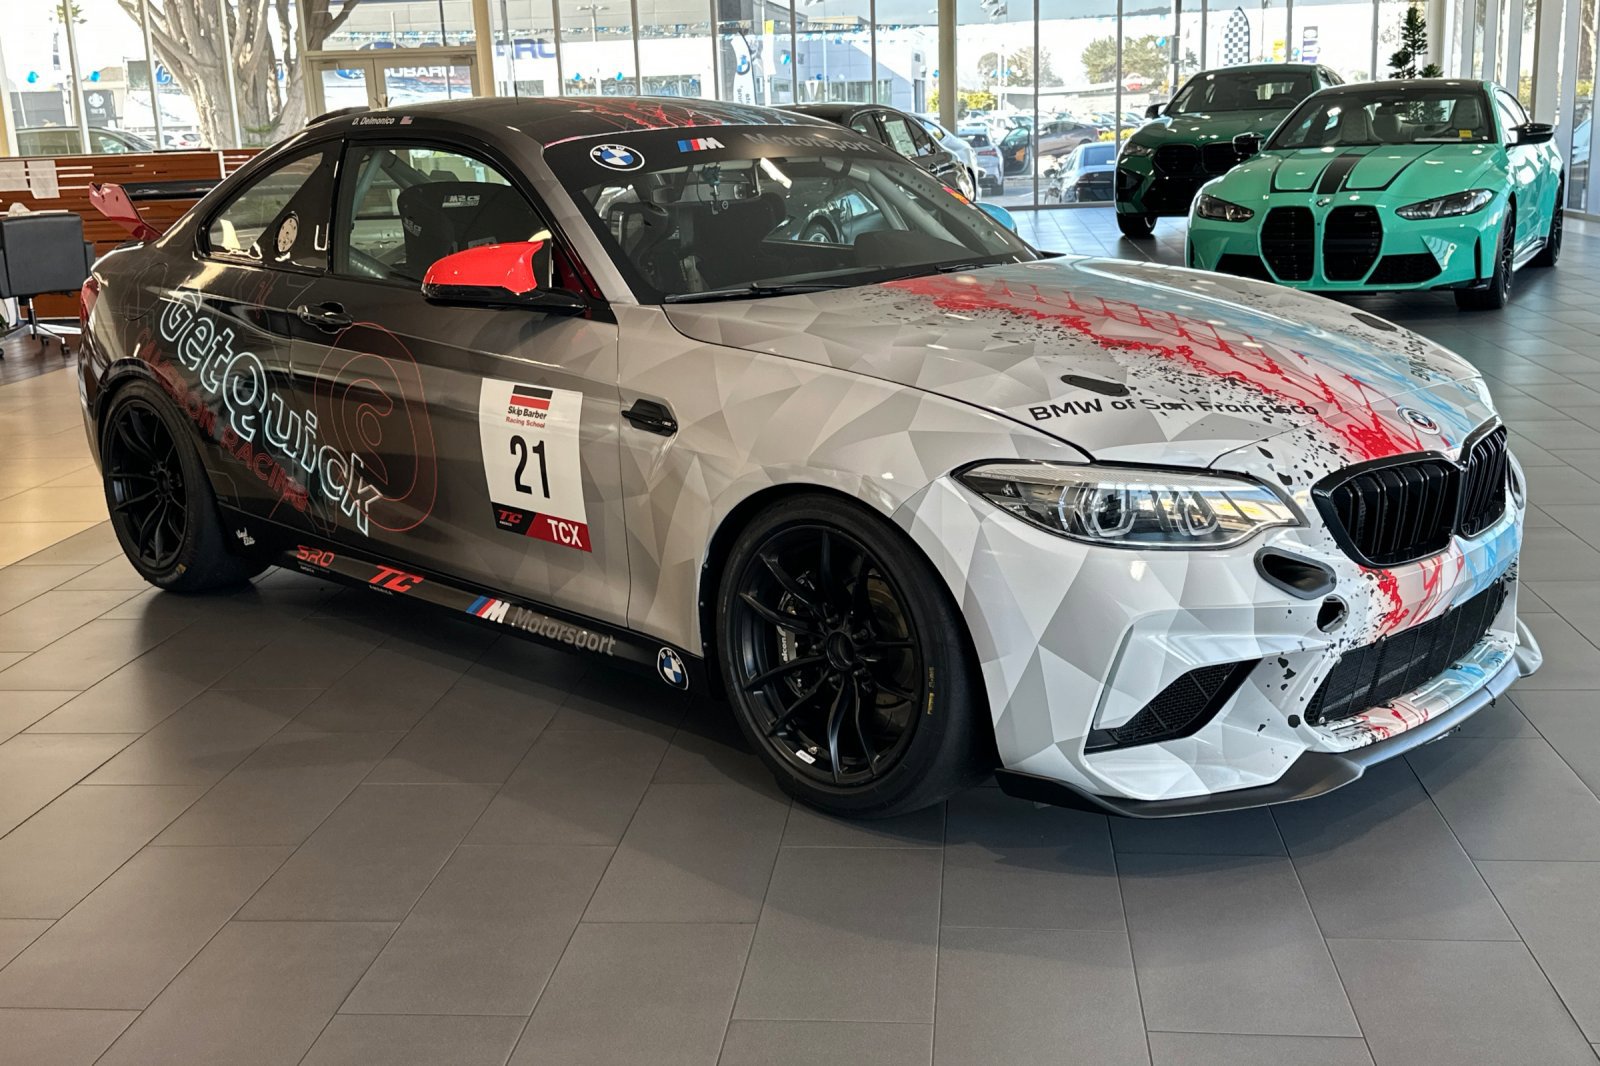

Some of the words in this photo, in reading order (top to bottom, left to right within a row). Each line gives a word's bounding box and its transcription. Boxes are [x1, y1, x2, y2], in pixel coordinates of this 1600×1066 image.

[360, 117, 396, 125] Delmonico
[742, 132, 876, 153] Motorsport
[507, 405, 523, 416] Skip
[523, 408, 548, 420] Barber
[1028, 398, 1103, 421] BMW
[1110, 398, 1137, 411] of
[1142, 399, 1195, 413] San
[1199, 400, 1319, 417] Francisco
[505, 416, 525, 426] Racing
[526, 419, 546, 428] School
[220, 425, 309, 512] RACING
[509, 434, 551, 499] 21
[498, 509, 523, 523] TC
[547, 518, 583, 547] TCX
[296, 544, 335, 567] SRO
[369, 564, 425, 593] TC
[510, 605, 617, 657] Motorsport
